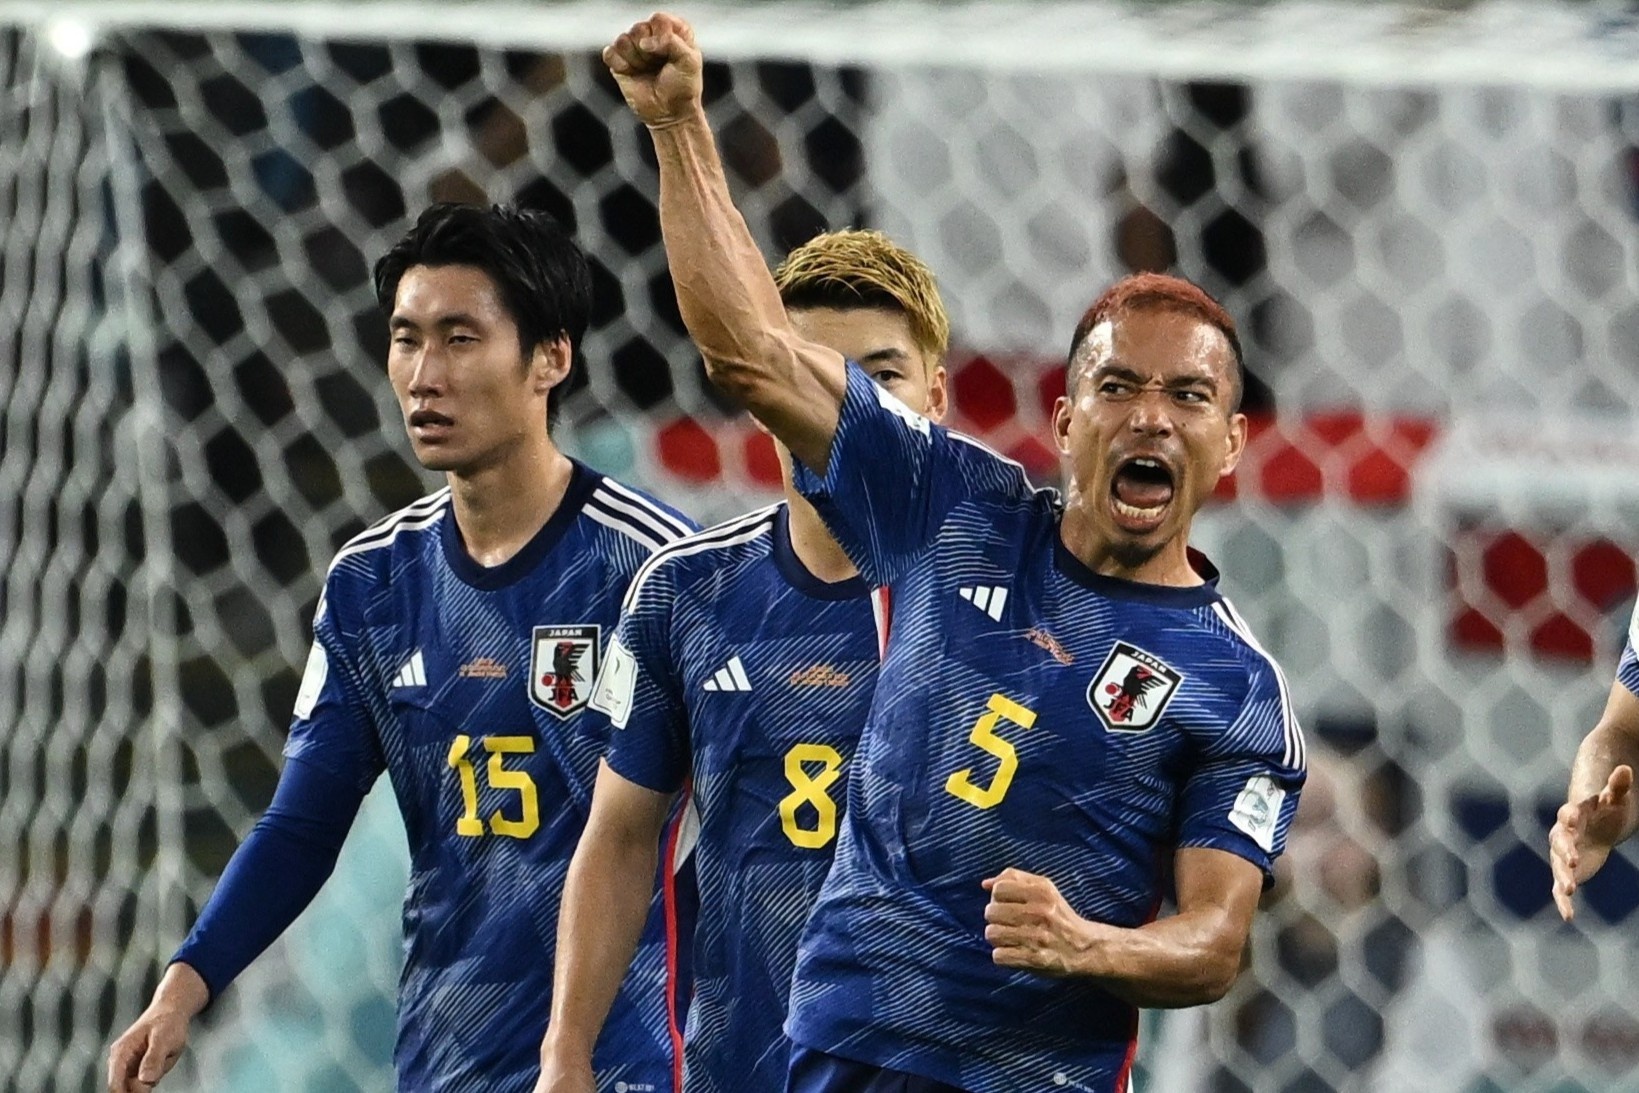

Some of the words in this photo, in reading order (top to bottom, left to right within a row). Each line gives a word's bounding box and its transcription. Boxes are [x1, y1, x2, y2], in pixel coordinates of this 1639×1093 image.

[549, 629, 583, 637] JAPAN
[1130, 650, 1168, 674] JAPAN
[548, 687, 580, 701] JFA
[1103, 698, 1134, 722] JFA
[945, 695, 1036, 809] 5
[447, 735, 540, 839] 15
[780, 743, 840, 849] 8
